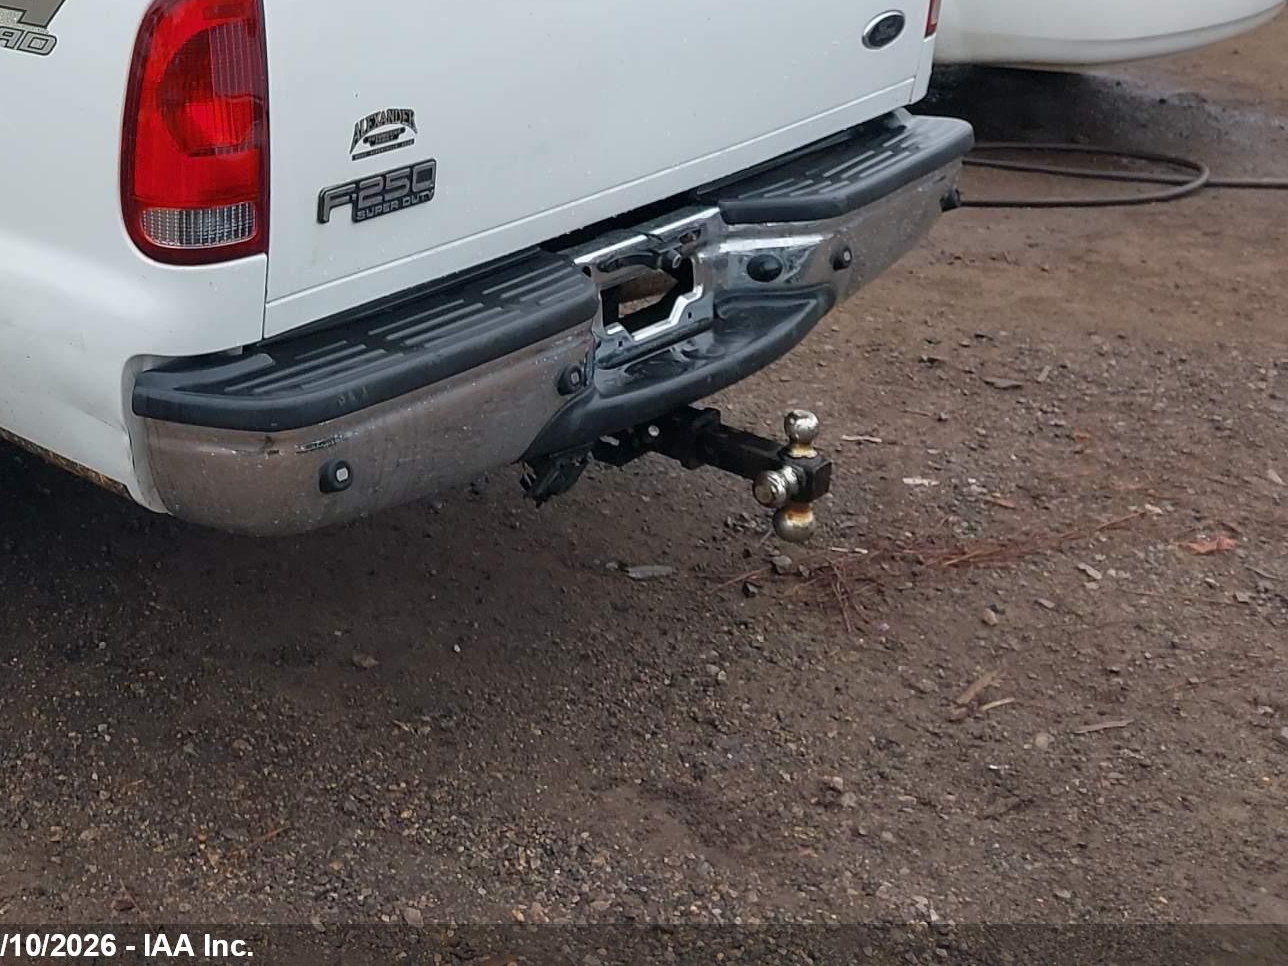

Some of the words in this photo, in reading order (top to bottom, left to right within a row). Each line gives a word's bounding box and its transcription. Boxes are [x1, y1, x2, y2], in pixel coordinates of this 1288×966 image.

[349, 108, 418, 154] ALEXANDER
[356, 200, 399, 221] SUPER
[402, 189, 435, 207] DUTY
